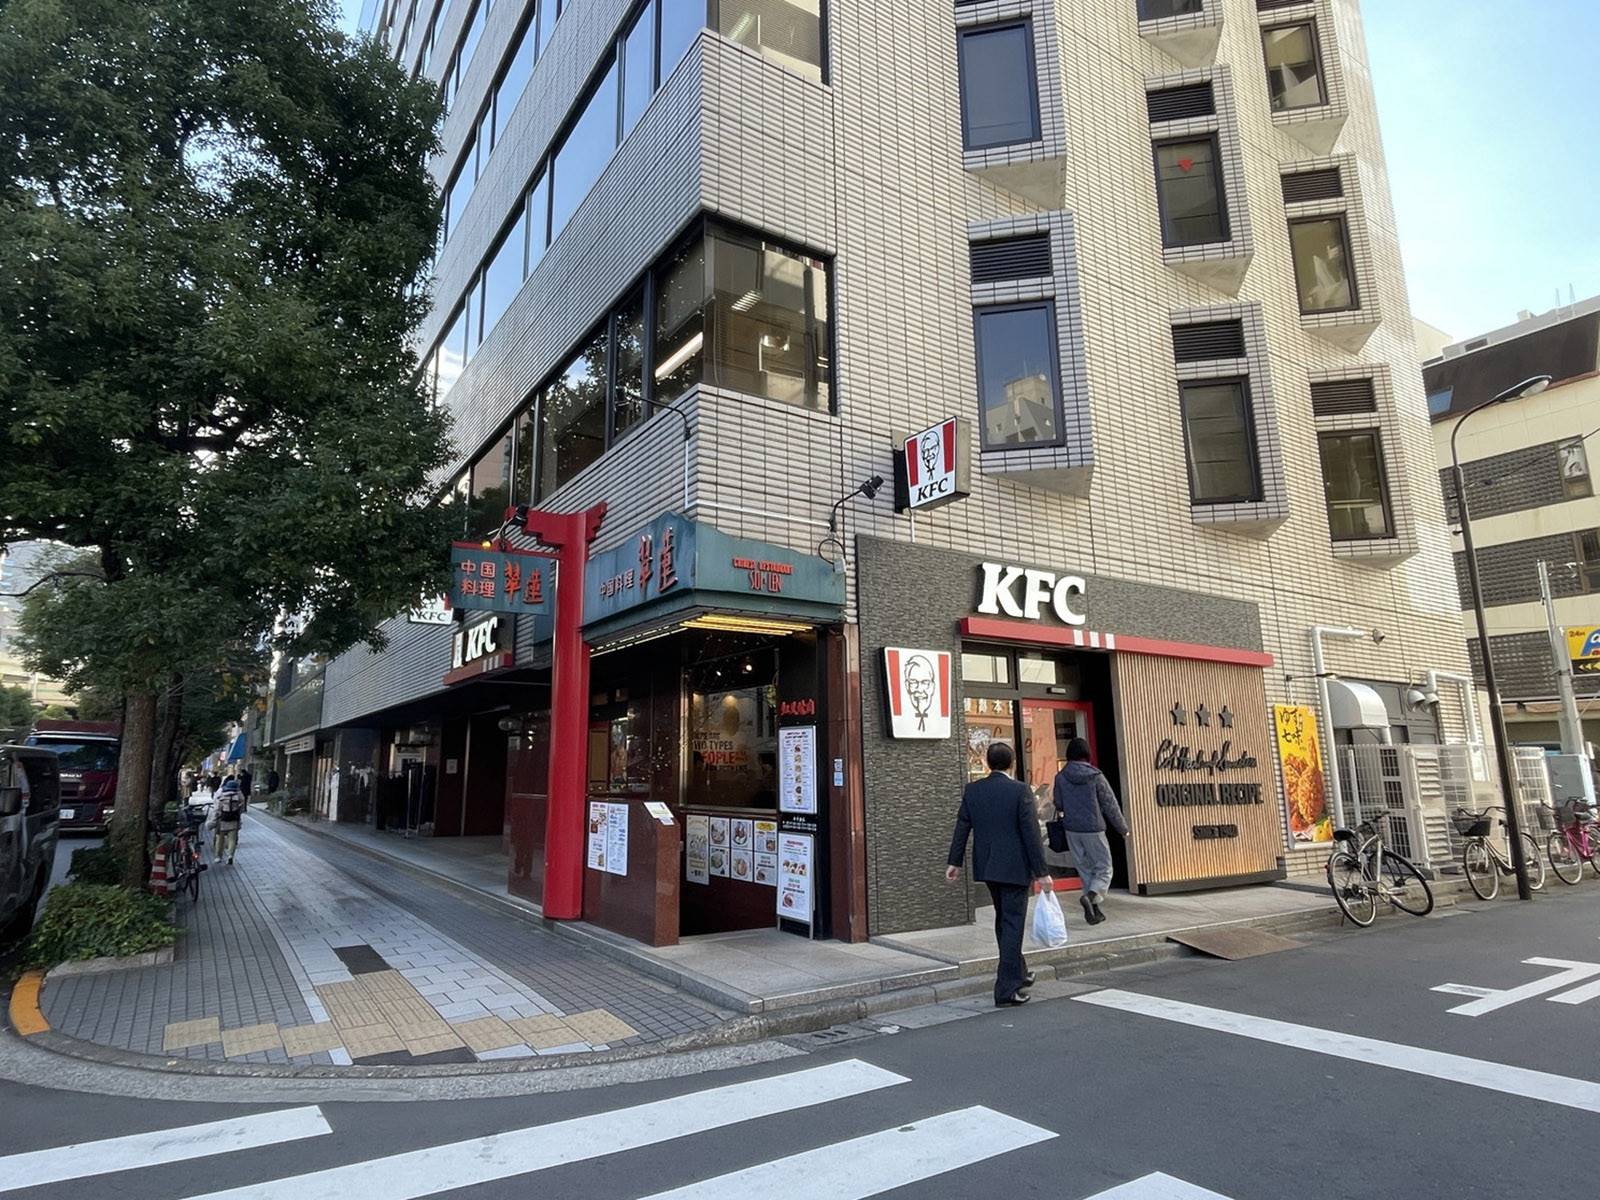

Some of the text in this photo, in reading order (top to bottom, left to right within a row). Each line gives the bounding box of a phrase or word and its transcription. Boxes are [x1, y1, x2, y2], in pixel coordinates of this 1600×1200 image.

[917, 478, 948, 502] KFC
[461, 560, 495, 578] 中国
[461, 579, 496, 598] 料理
[600, 569, 635, 599] 中国料理
[978, 562, 1086, 626] KFC
[418, 611, 447, 622] KFC
[465, 616, 498, 662] KFC
[709, 741, 734, 750] TYPES
[1156, 783, 1264, 807] ORIGINAL RECIPE
